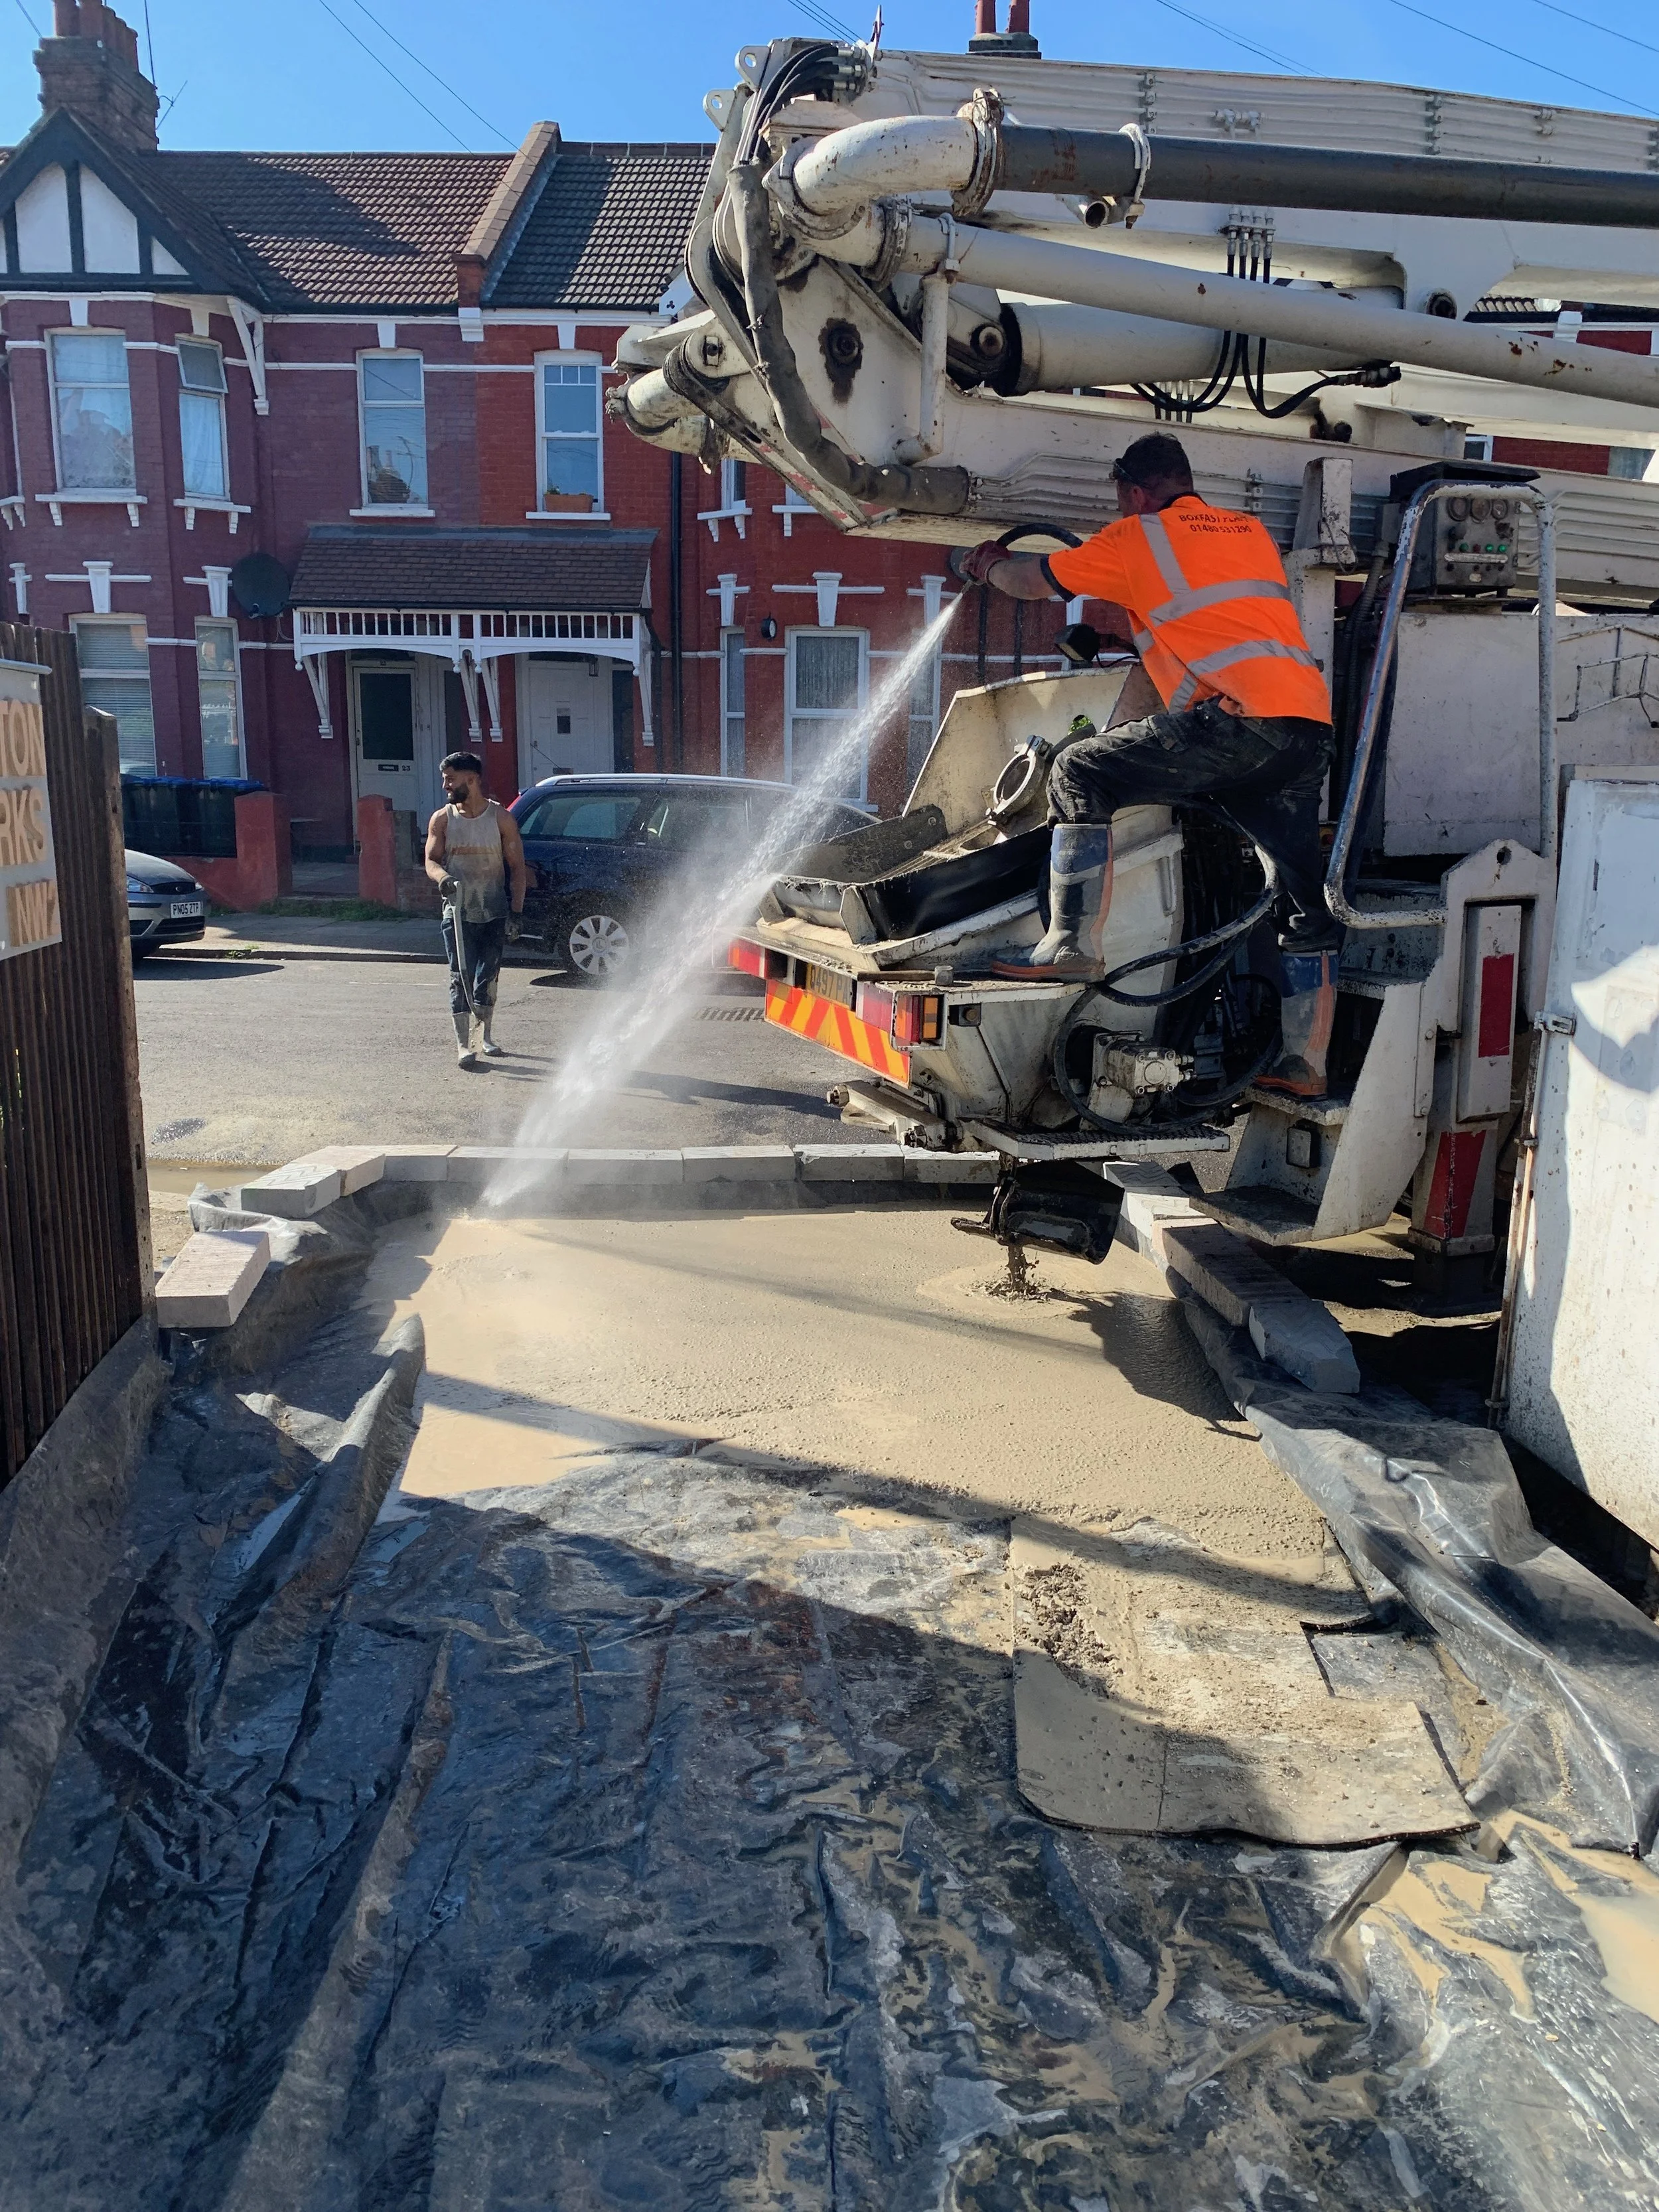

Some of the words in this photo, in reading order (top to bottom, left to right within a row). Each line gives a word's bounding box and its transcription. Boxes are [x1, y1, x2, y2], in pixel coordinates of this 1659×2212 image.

[1190, 524, 1219, 532] 01480
[1220, 525, 1252, 534] 531290
[173, 903, 188, 915] PN05
[189, 903, 199, 914] ZTP
